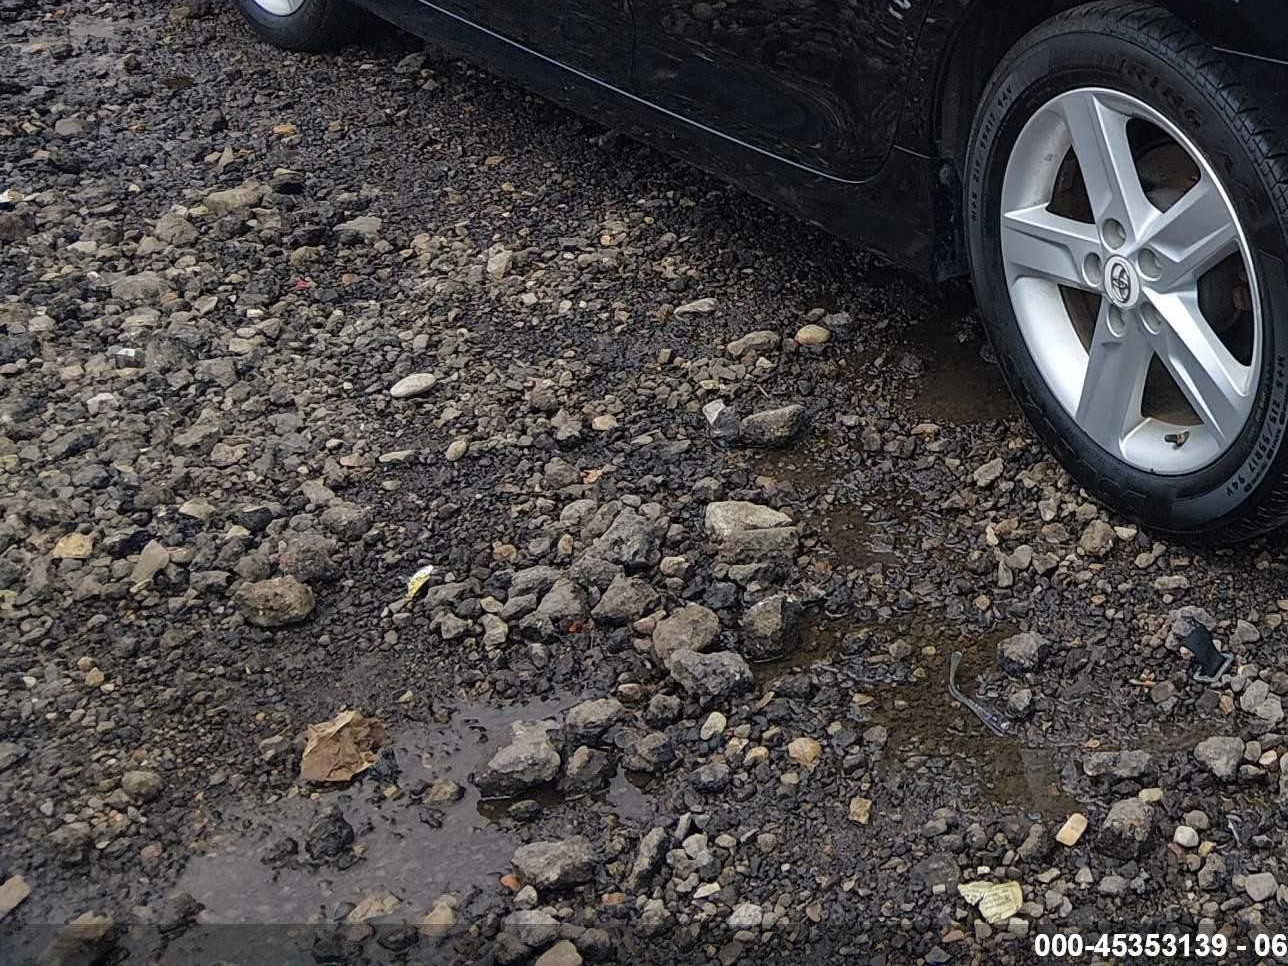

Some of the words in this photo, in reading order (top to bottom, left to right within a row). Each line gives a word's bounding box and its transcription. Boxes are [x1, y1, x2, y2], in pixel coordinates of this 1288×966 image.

[1275, 355, 1286, 390] M+S
[1248, 398, 1281, 474] 215/55R17
[1225, 474, 1246, 498] 94V
